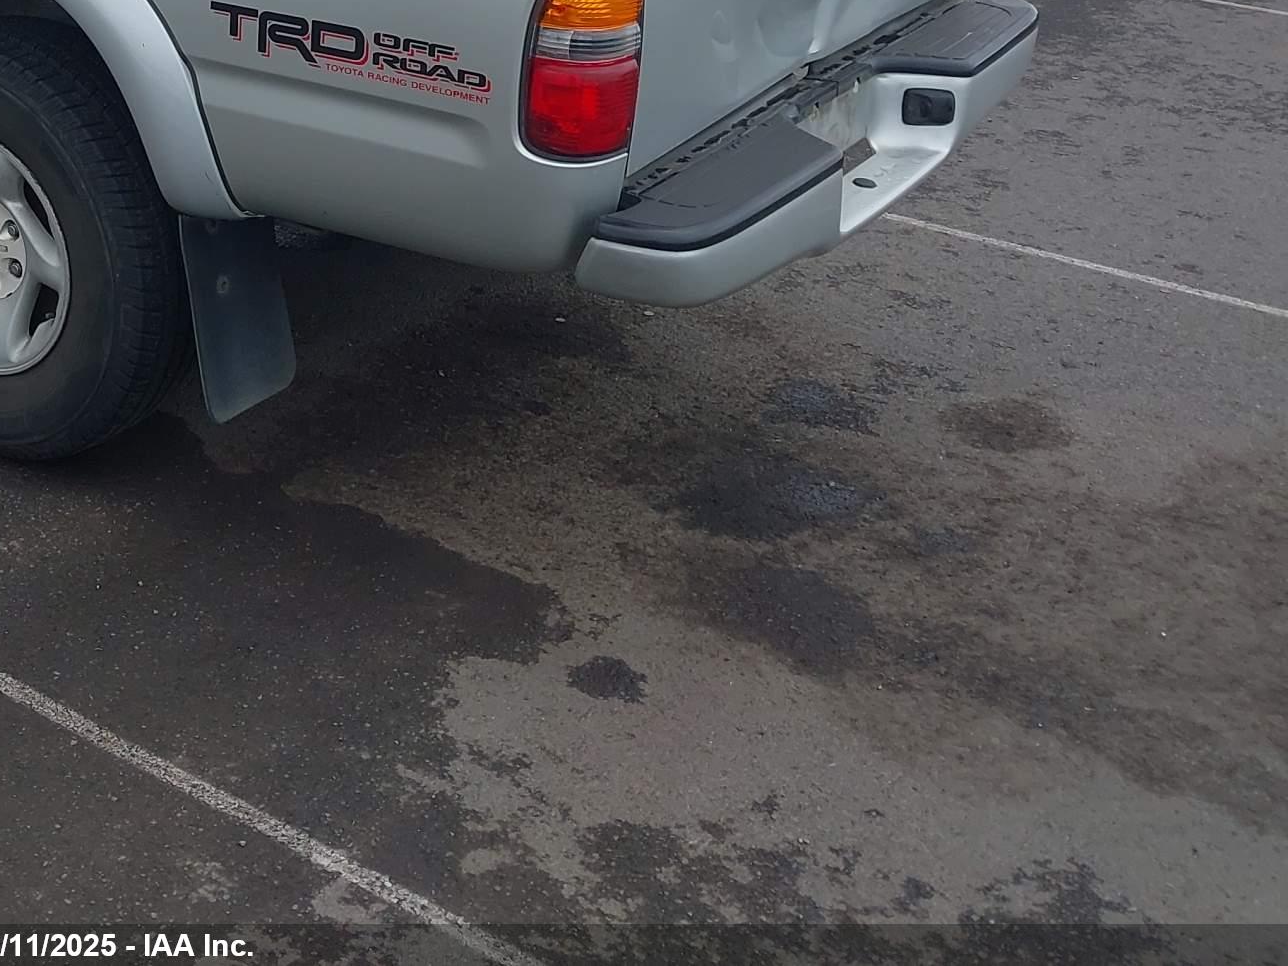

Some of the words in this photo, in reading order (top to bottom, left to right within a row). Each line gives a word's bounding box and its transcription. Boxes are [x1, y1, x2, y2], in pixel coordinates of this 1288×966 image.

[210, 0, 369, 68] TRD
[373, 32, 459, 62] OFF
[326, 63, 365, 79] TOYOTA
[368, 72, 408, 88] RACING
[411, 81, 491, 106] DEVELOPMENT
[372, 52, 491, 93] ROAD
